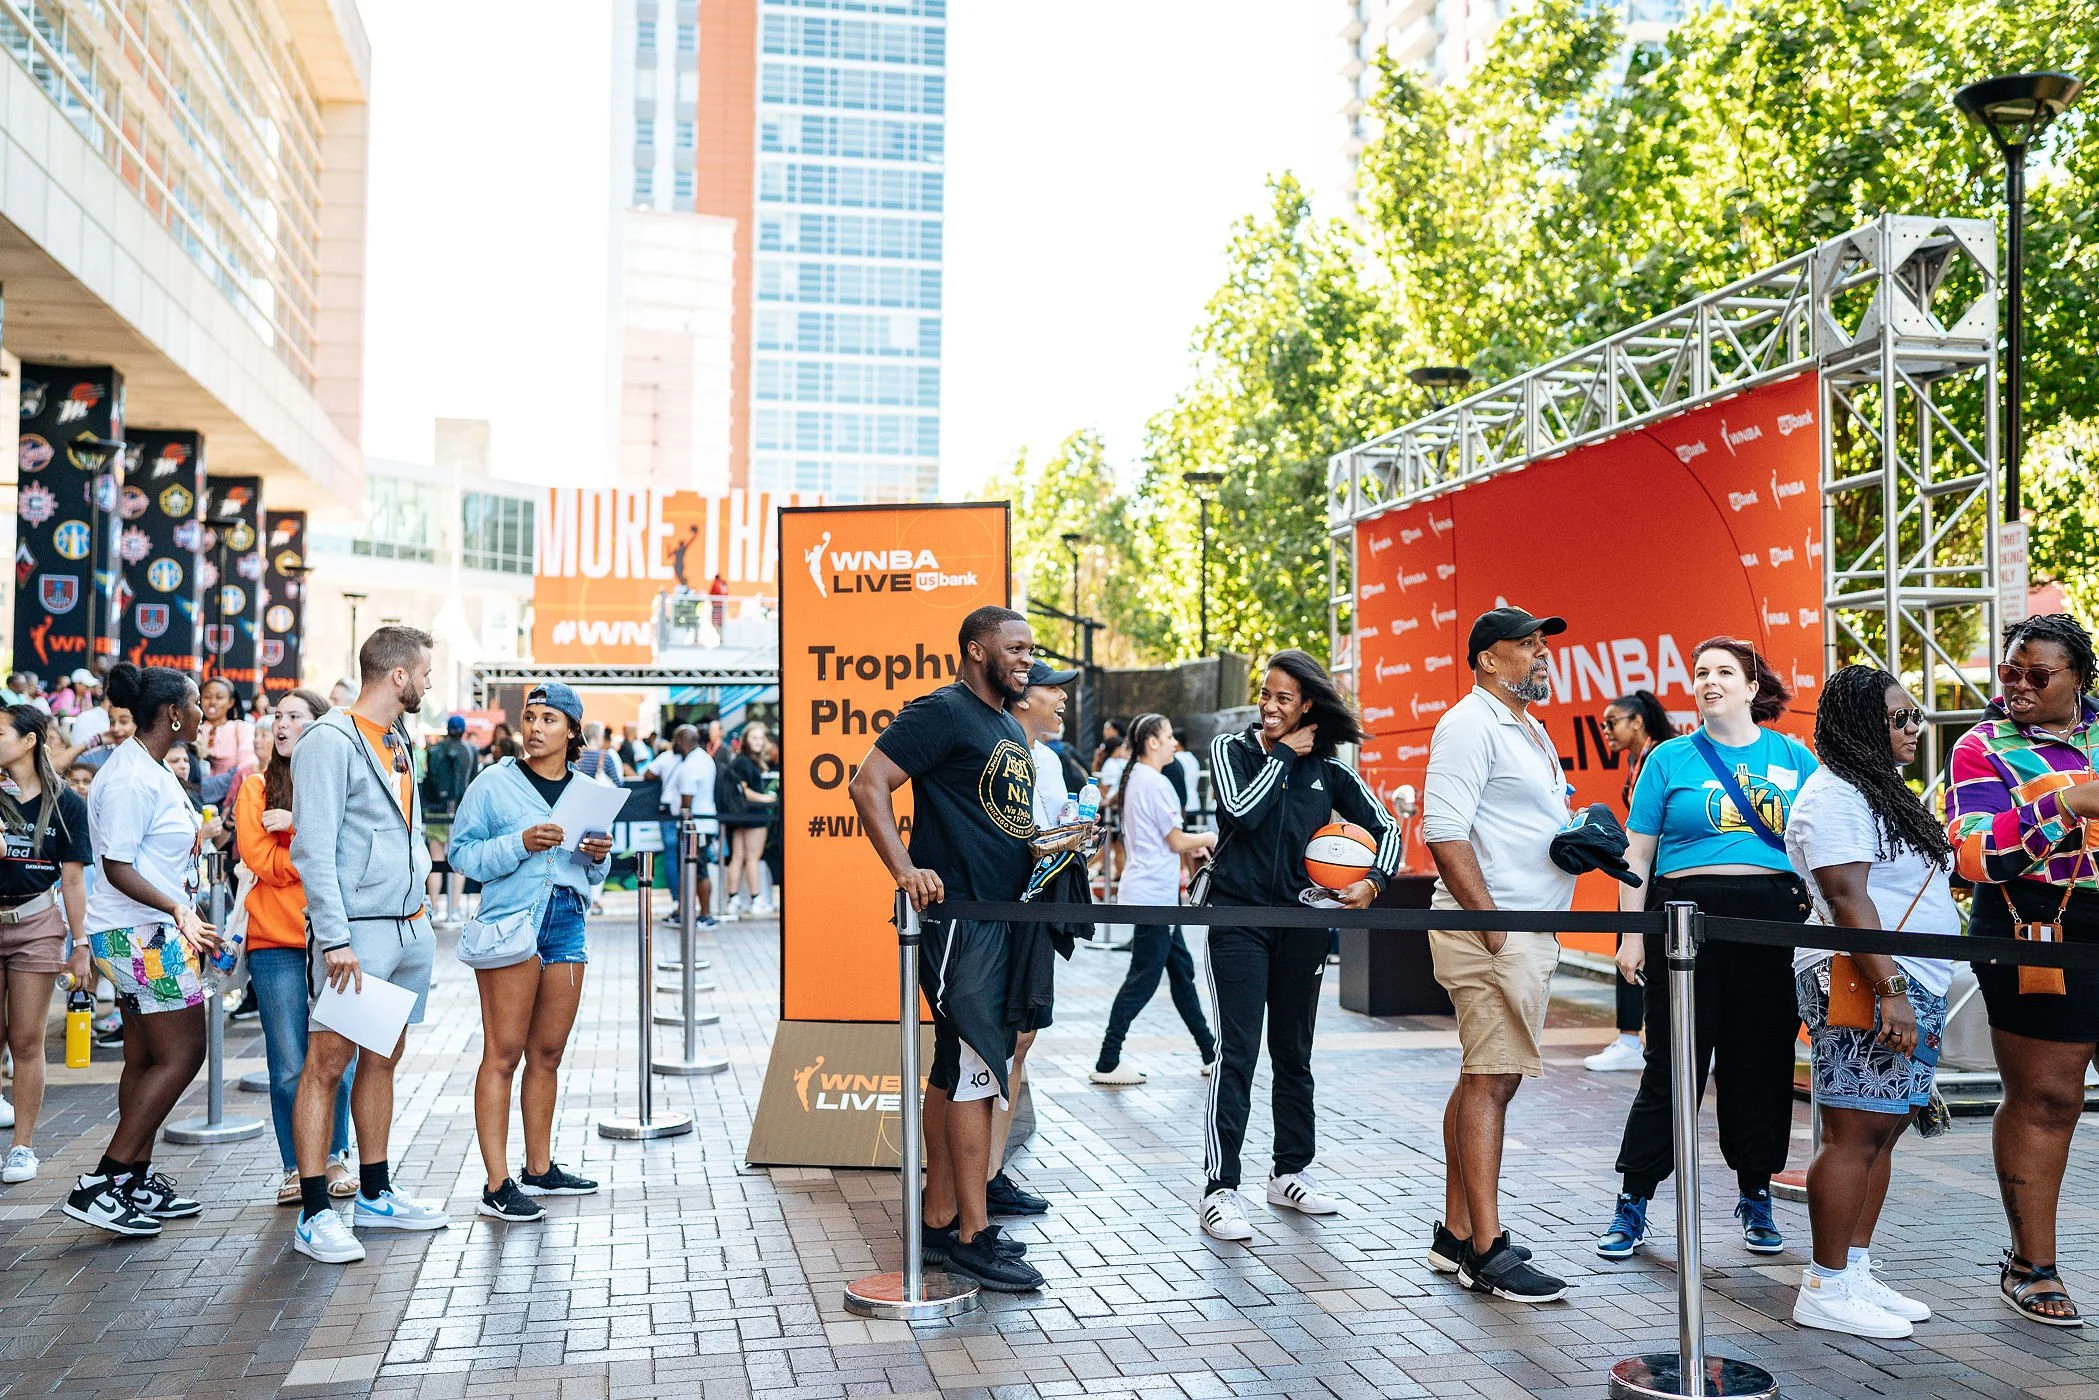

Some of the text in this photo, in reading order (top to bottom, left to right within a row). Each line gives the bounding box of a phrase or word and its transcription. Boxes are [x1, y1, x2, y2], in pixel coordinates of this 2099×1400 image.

[534, 488, 676, 579] MORE
[830, 550, 940, 572] WNBA
[833, 573, 912, 593] LIVE
[811, 699, 908, 735] Pho
[986, 801, 1009, 829] CHICAGO
[1009, 825, 1024, 835] STATE
[815, 1093, 901, 1112] LIVE
